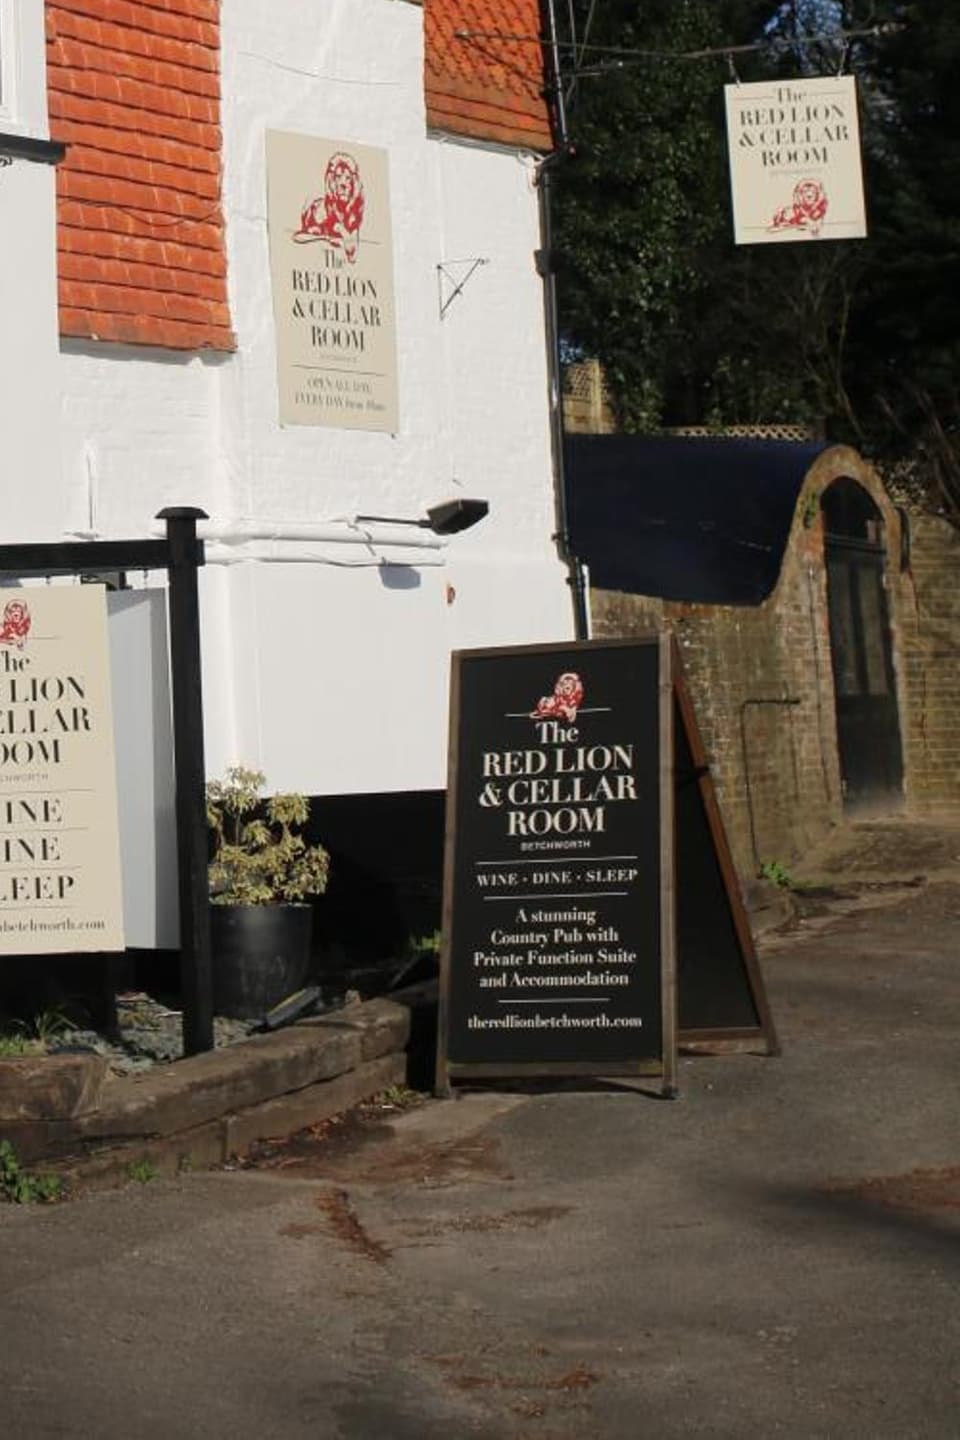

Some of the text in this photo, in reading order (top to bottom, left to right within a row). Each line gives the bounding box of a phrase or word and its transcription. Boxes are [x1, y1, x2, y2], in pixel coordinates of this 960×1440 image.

[775, 88, 807, 103] The
[740, 104, 845, 126] RED LION
[739, 125, 849, 148] & CELLAR
[761, 147, 828, 166] ROOM
[322, 249, 344, 268] The
[292, 269, 377, 299] RED LION
[292, 298, 381, 327] & CELLAR
[311, 325, 365, 352] ROOM
[10, 675, 85, 703] LION
[536, 721, 580, 744] The
[482, 744, 634, 777] RED LION
[479, 775, 638, 808] & CELLAR
[507, 806, 606, 836] ROOM
[520, 839, 591, 852] BETCHWORTH
[476, 868, 639, 887] WINE DINE SLEEP
[515, 906, 597, 926] A stunning
[490, 926, 620, 949] Country Pub with
[473, 948, 637, 967] Private Function Suite
[479, 970, 630, 988] and Accommodation
[467, 1013, 643, 1030] theredlionbetchworth.com
